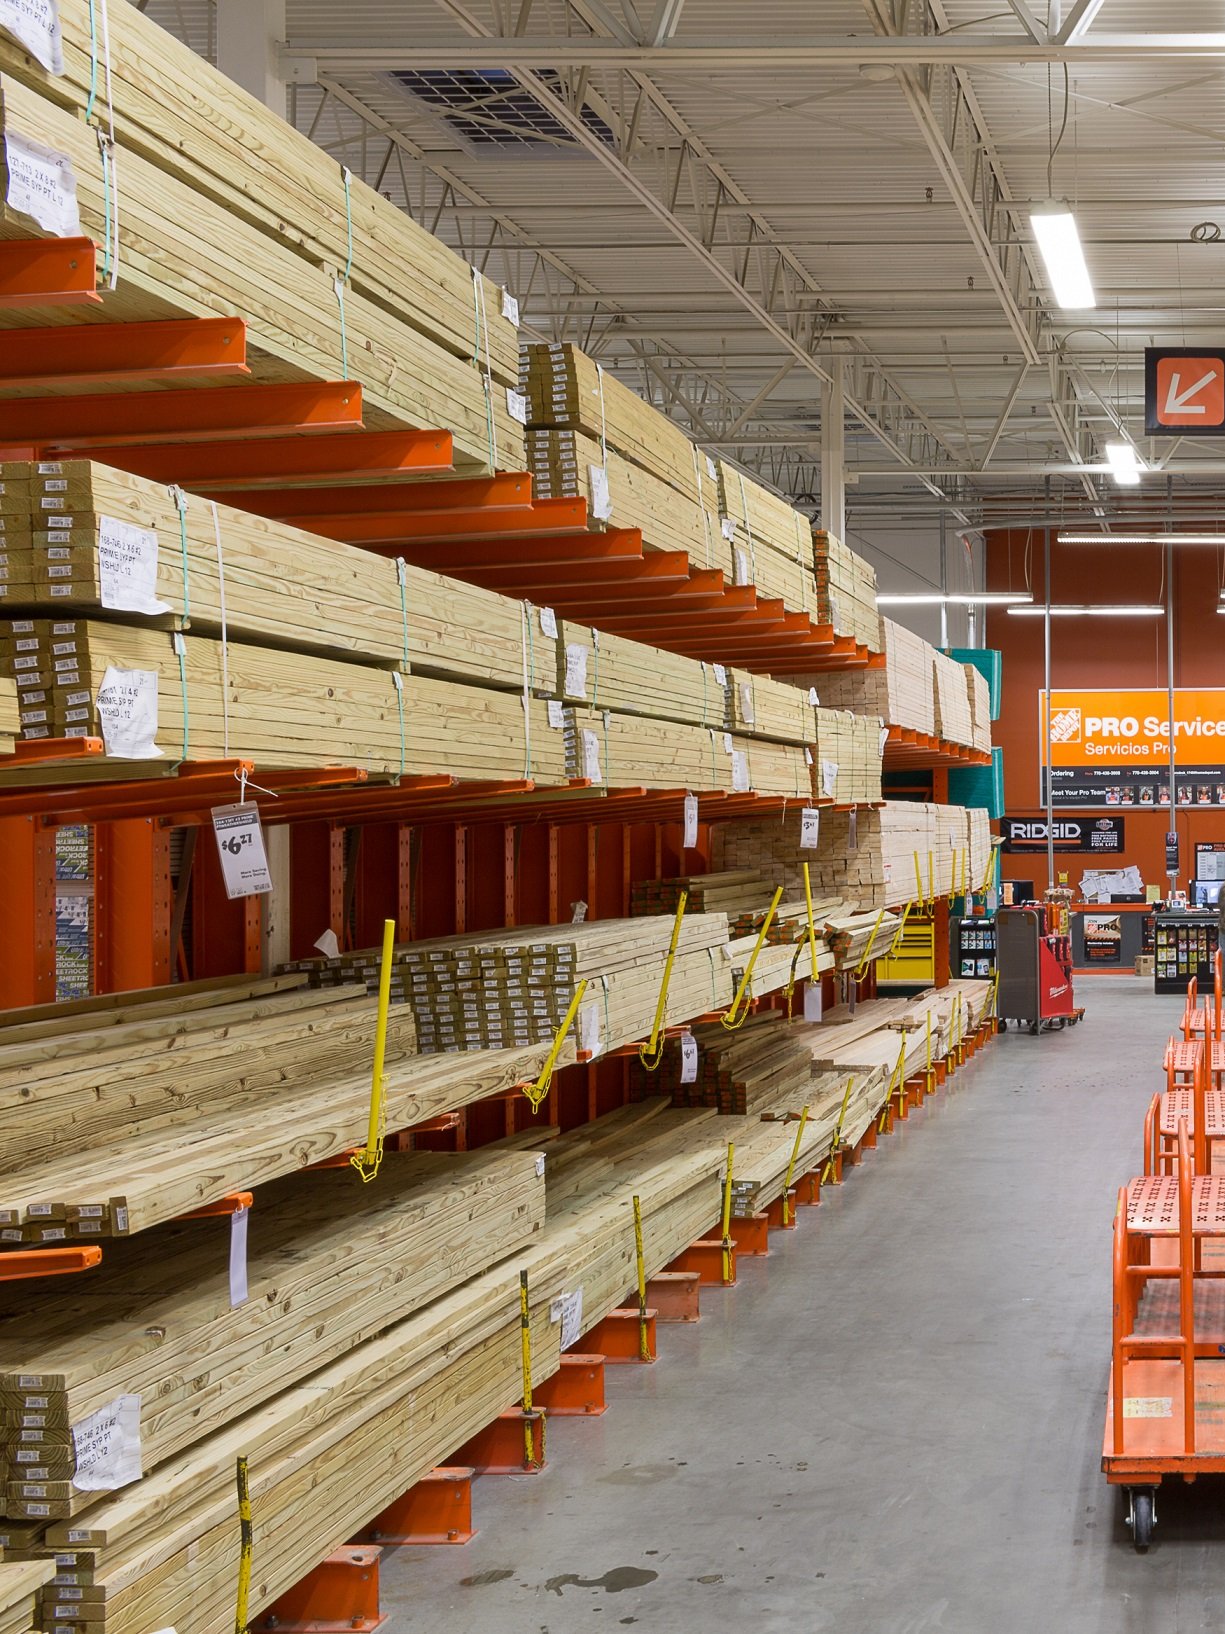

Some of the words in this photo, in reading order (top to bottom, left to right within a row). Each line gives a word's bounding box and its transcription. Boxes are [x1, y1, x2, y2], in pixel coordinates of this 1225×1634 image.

[1085, 717, 1139, 737] PRO
[1085, 742, 1150, 756] Servicios
[1153, 742, 1177, 755] Pro
[1050, 770, 1074, 778] Ordering
[1010, 823, 1081, 838] RIDGID
[92, 1436, 103, 1450] SYP
[104, 1431, 112, 1443] PT
